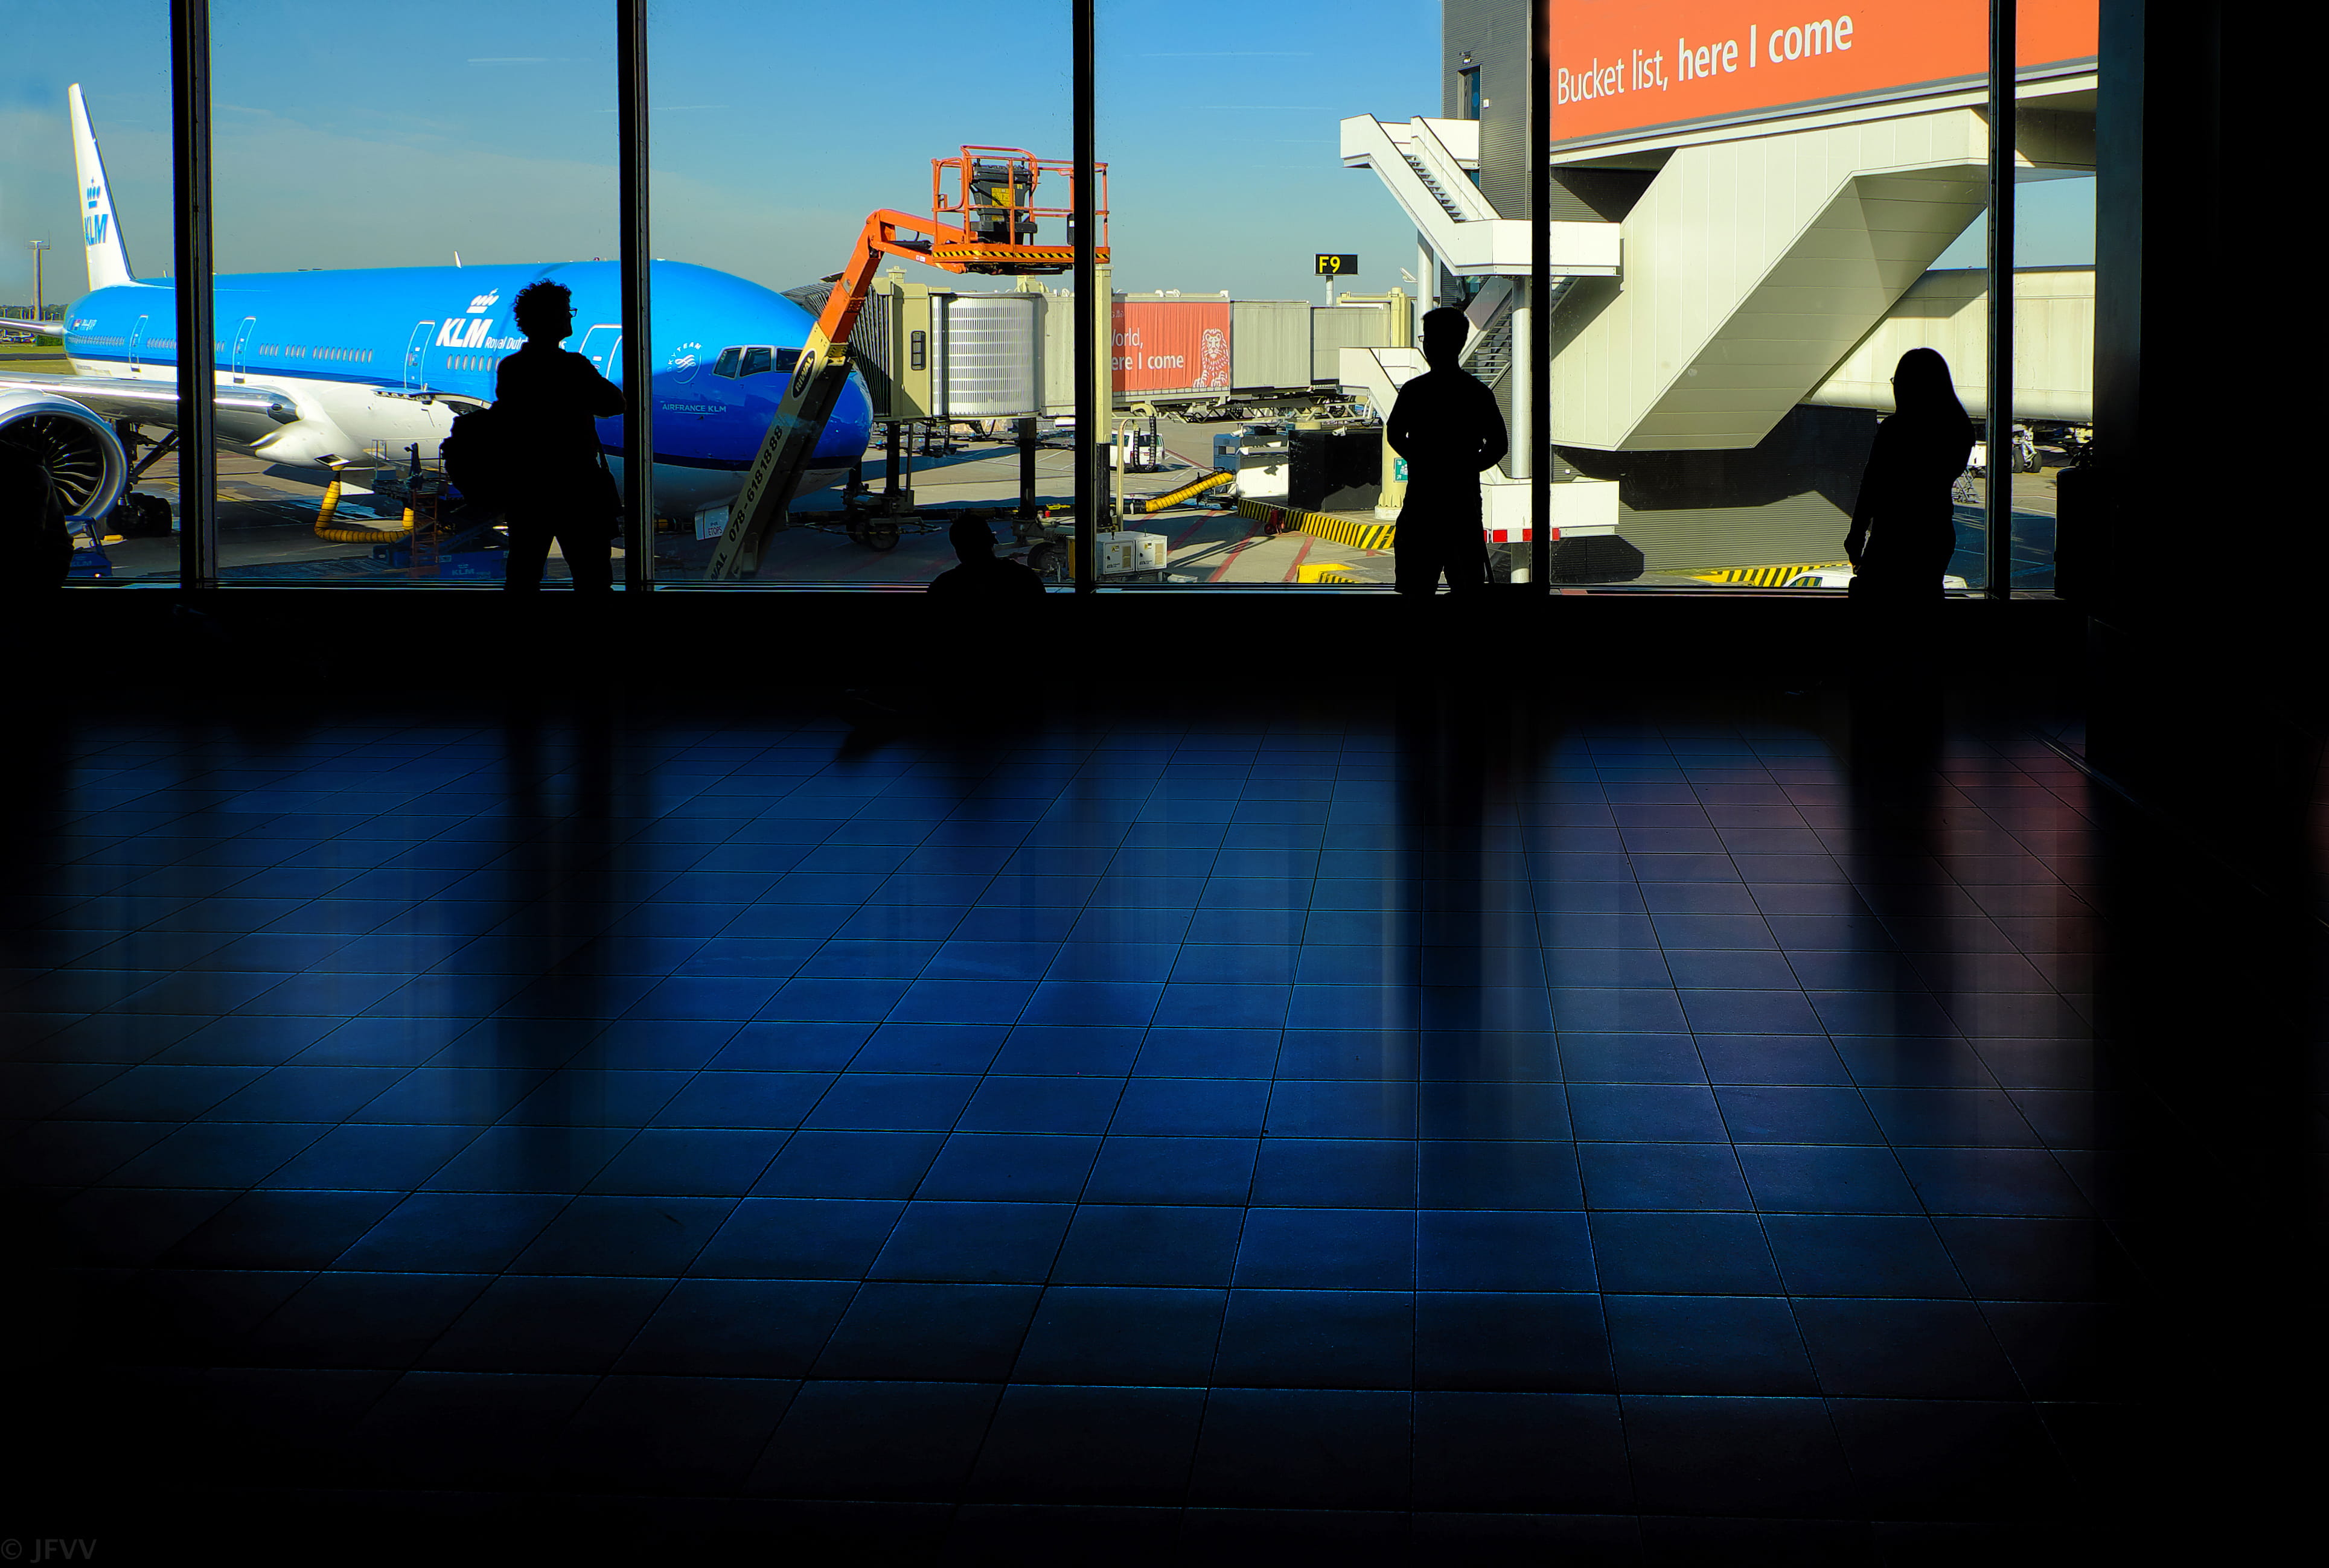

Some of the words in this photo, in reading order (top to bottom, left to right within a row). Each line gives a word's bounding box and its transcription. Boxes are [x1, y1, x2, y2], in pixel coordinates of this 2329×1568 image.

[1557, 58, 1625, 105] Bucket
[1632, 48, 1669, 92] list,
[1678, 37, 1739, 82] here
[1749, 24, 1757, 68] I
[1768, 15, 1854, 63] come
[85, 214, 109, 246] KLM
[1319, 256, 1341, 273] F9
[435, 317, 494, 348] KLM
[484, 336, 508, 352] Royal
[1112, 327, 1143, 349] orld,
[677, 342, 702, 352] TEAM
[1112, 355, 1133, 371] ere
[1138, 352, 1142, 369] I
[1147, 355, 1184, 369] come
[795, 357, 814, 392] RIWAL
[708, 526, 723, 536] ETOPS
